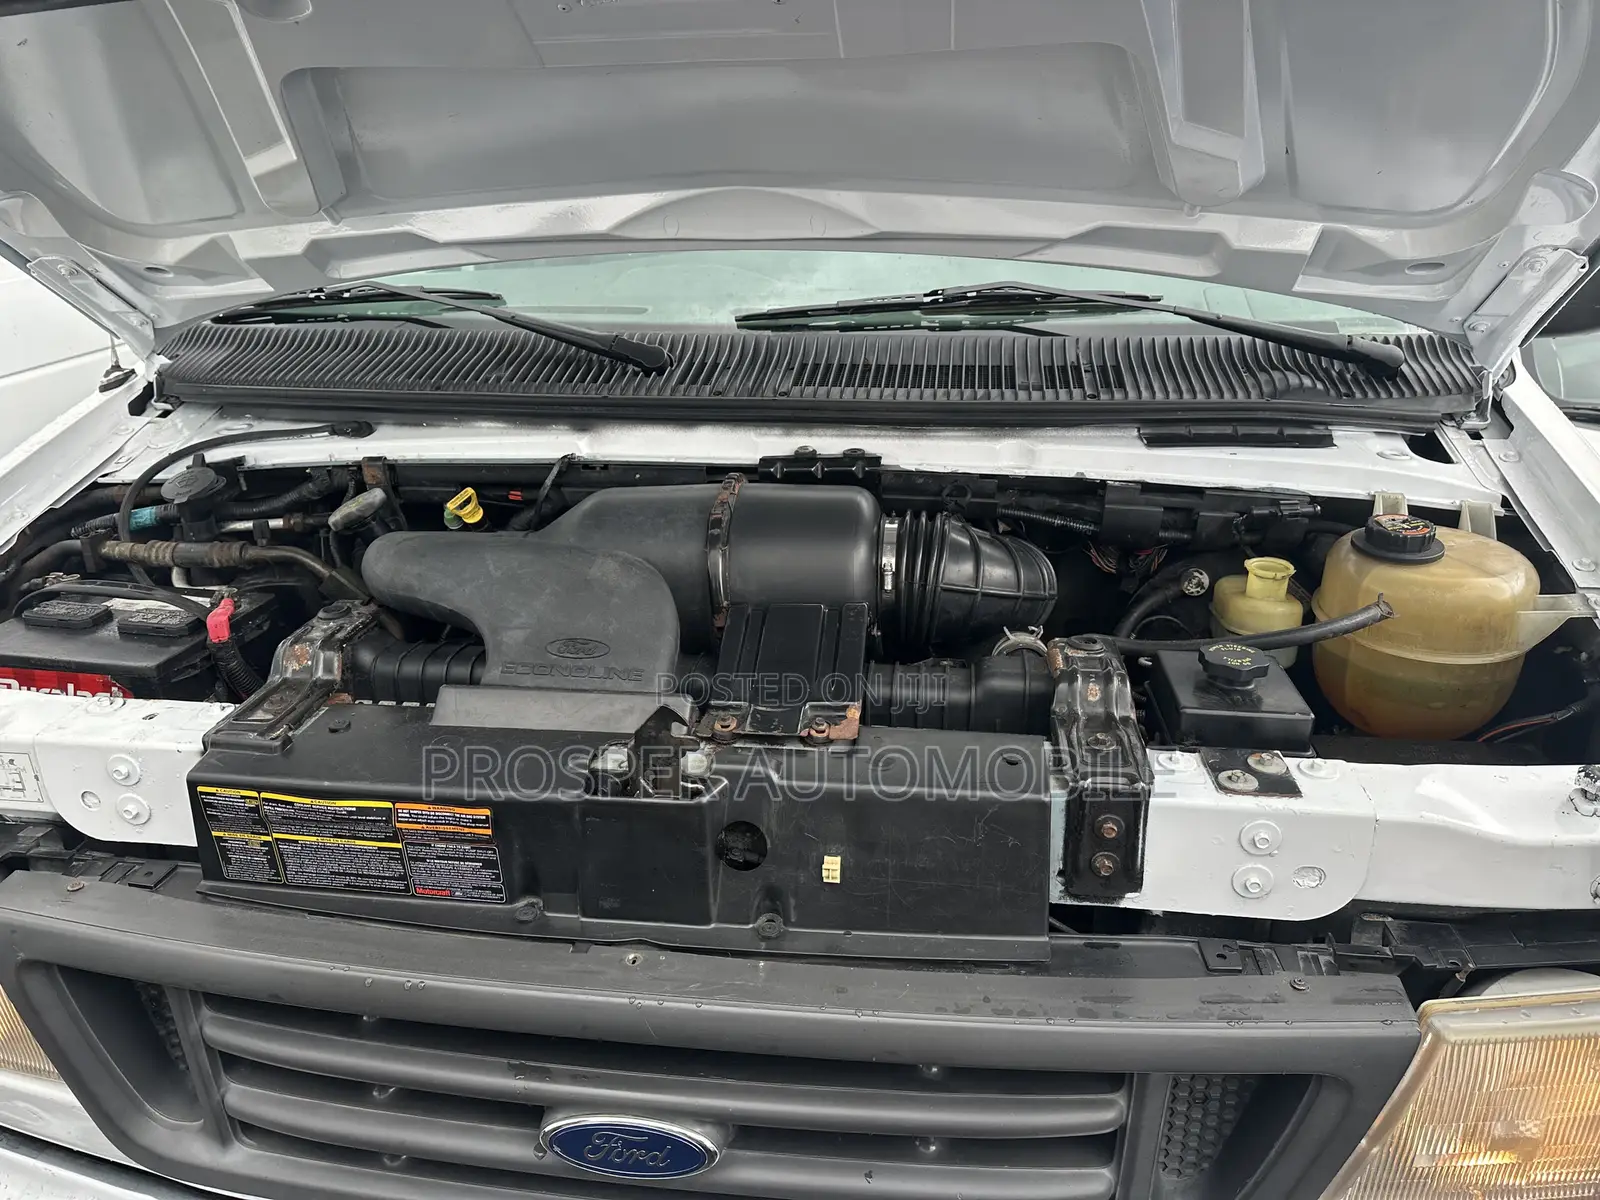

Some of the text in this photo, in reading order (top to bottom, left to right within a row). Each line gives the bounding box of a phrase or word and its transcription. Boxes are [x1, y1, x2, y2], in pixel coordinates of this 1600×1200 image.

[500, 661, 645, 682] ECONOLINE
[416, 887, 451, 897] Motorcraft
[584, 1131, 674, 1167] Ford
